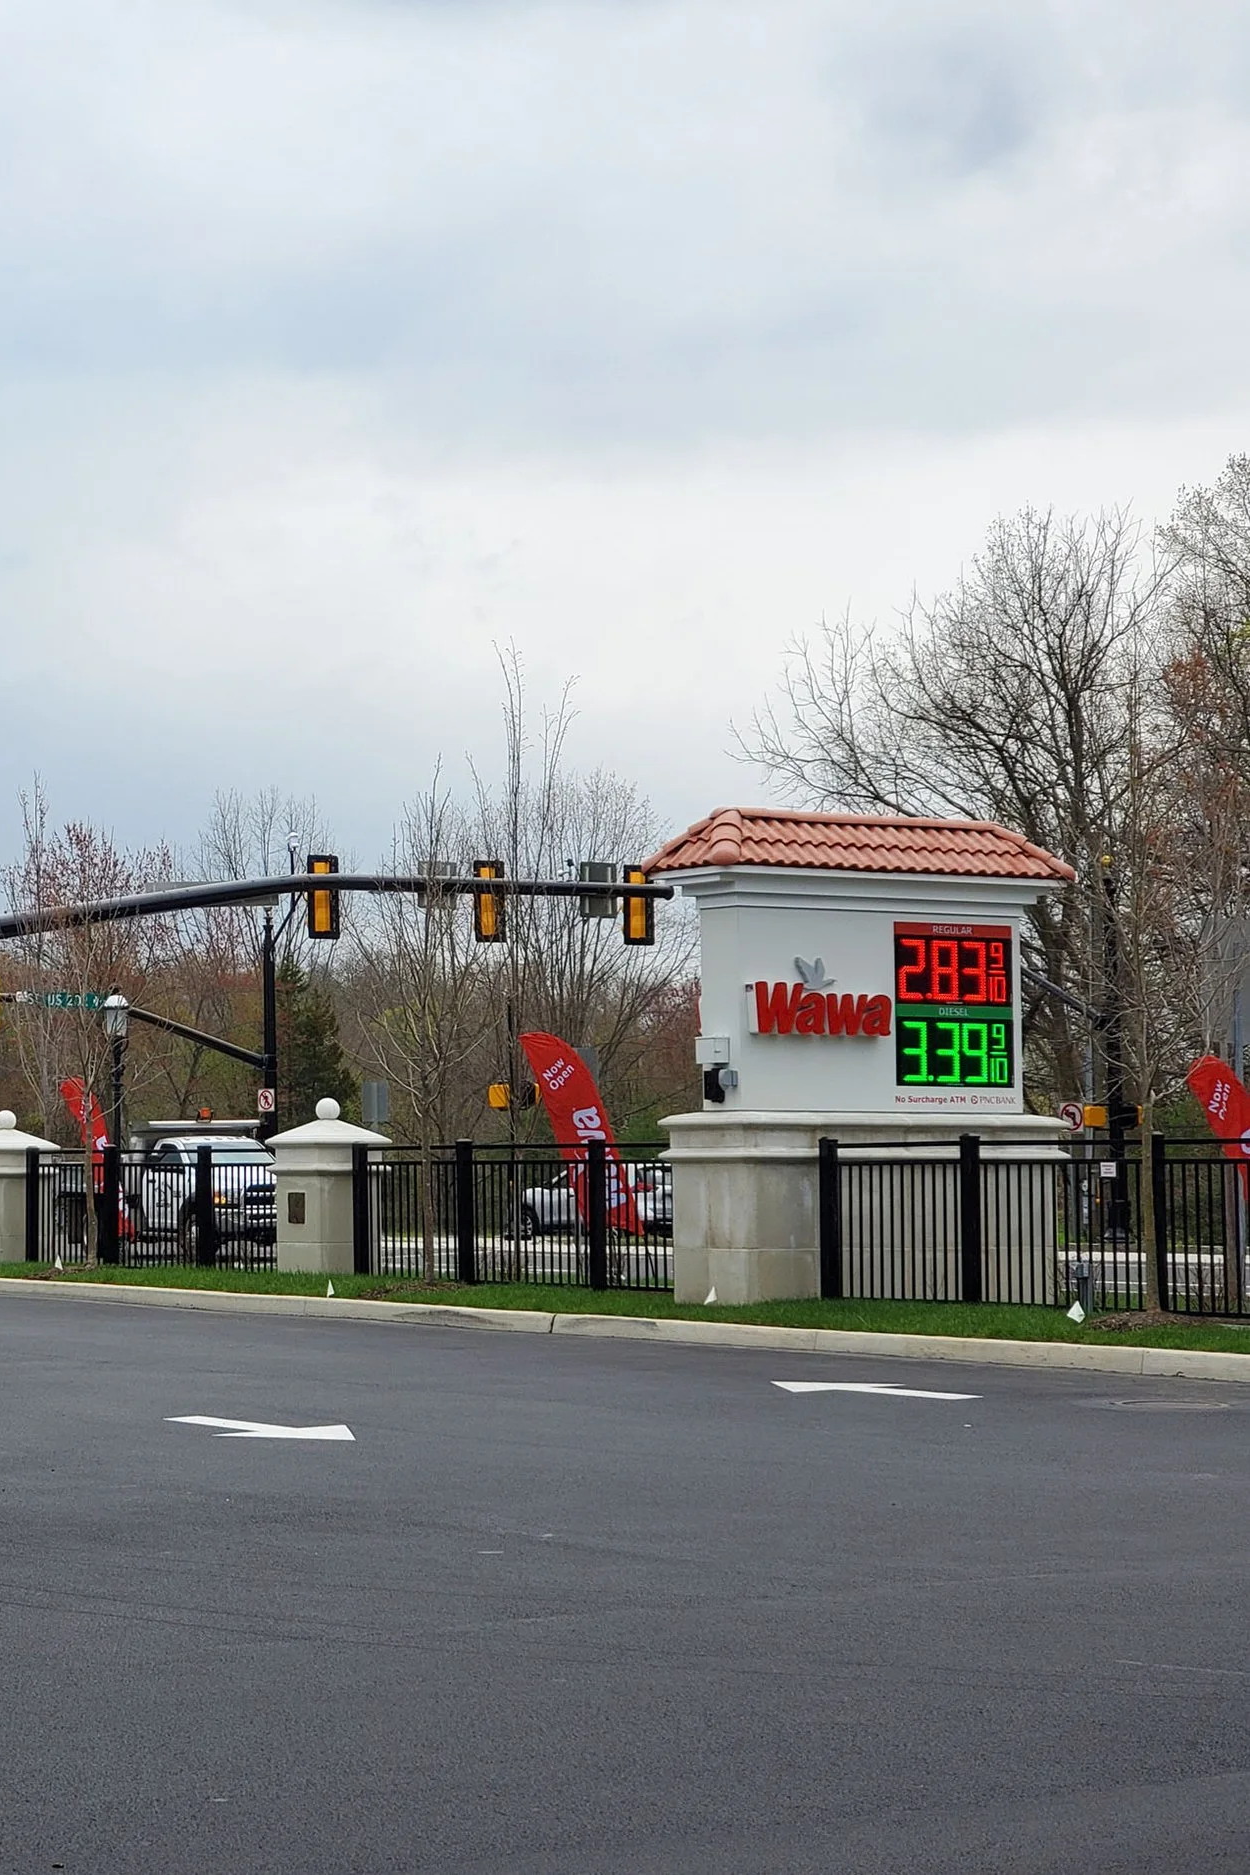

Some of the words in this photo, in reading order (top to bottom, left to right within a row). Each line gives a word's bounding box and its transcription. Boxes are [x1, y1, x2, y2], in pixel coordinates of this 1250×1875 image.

[932, 925, 973, 935] REGULAR
[898, 938, 987, 1002] 2.83
[47, 992, 62, 1007] US
[754, 980, 892, 1037] Wawa
[938, 1007, 969, 1016] DIESEL
[902, 1021, 989, 1083] 3.39
[542, 1057, 565, 1082] Now
[549, 1064, 575, 1091] Open
[895, 1095, 906, 1104] No
[907, 1095, 948, 1105] Surcharge
[950, 1096, 967, 1104] ATM
[1207, 1079, 1223, 1114] Now
